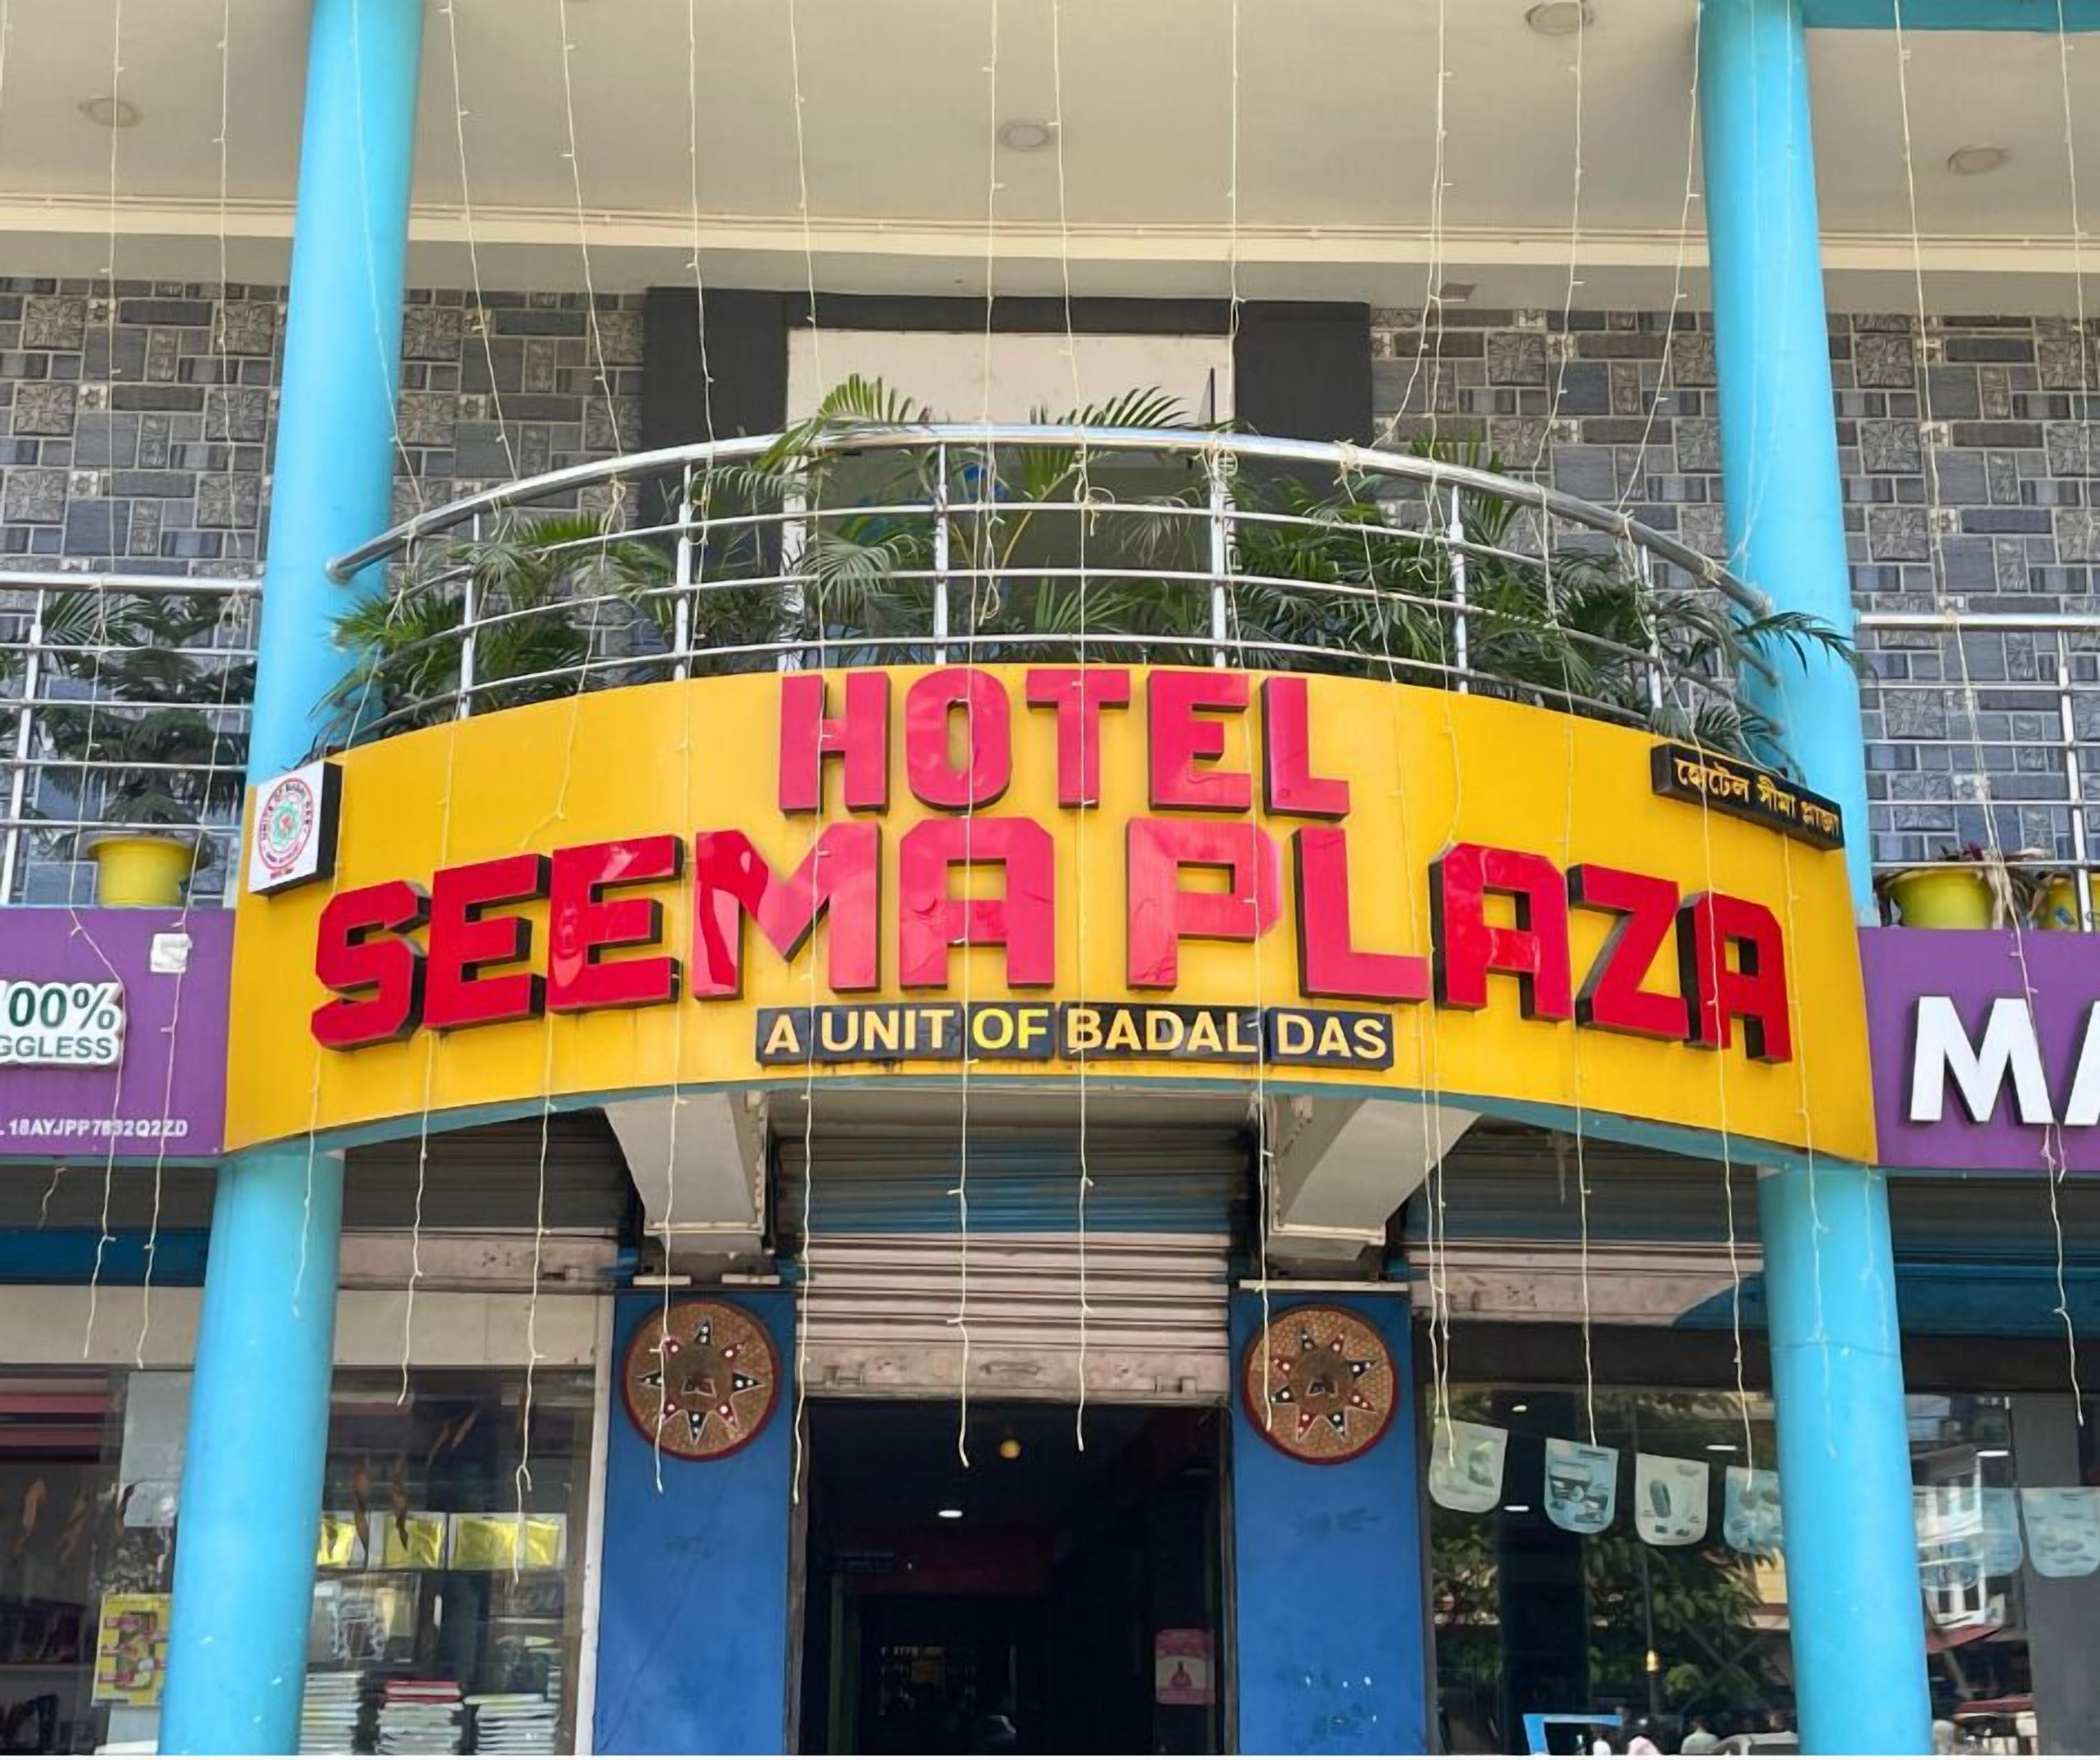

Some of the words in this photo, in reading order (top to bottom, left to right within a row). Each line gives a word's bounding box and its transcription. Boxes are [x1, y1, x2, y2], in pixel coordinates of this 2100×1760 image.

[780, 667, 1350, 821] HOTEL
[311, 817, 1056, 1051] SEEMA
[1125, 817, 1793, 1064] PLAZA
[0, 986, 115, 1030] 00%
[764, 1014, 800, 1054] A
[821, 1009, 954, 1051] UNIT
[972, 1008, 1049, 1049] OF
[1067, 1008, 1259, 1053] BADAL
[1277, 1013, 1387, 1059] DAS
